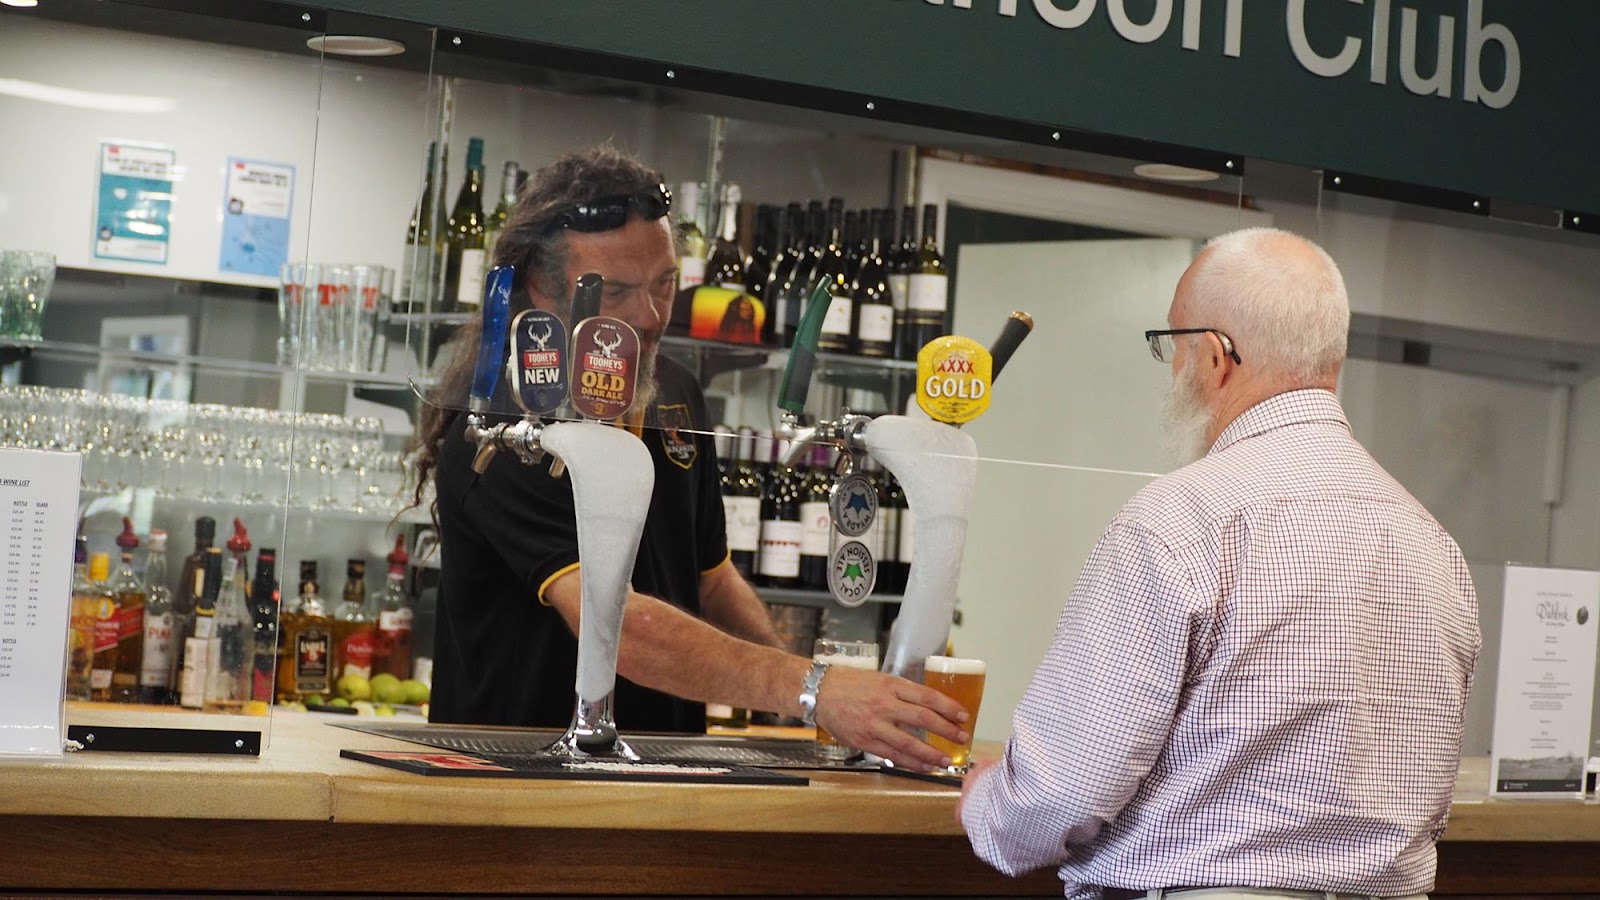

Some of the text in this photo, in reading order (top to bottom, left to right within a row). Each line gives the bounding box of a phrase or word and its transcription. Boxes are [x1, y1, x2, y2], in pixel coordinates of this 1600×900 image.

[1286, 0, 1522, 109] Club
[528, 352, 557, 364] TOOHEYS
[588, 355, 624, 369] TOOHEYS
[936, 359, 975, 375] XXXX
[525, 368, 560, 385] NEW
[582, 370, 626, 393] OLD
[582, 387, 606, 398] DARK
[606, 390, 624, 401] ALE
[925, 374, 986, 400] GOLD
[3, 479, 18, 487] WINE
[843, 511, 871, 531] WYADRA
[835, 547, 870, 574] SESSION ALE
[839, 582, 865, 598] LOCAL
